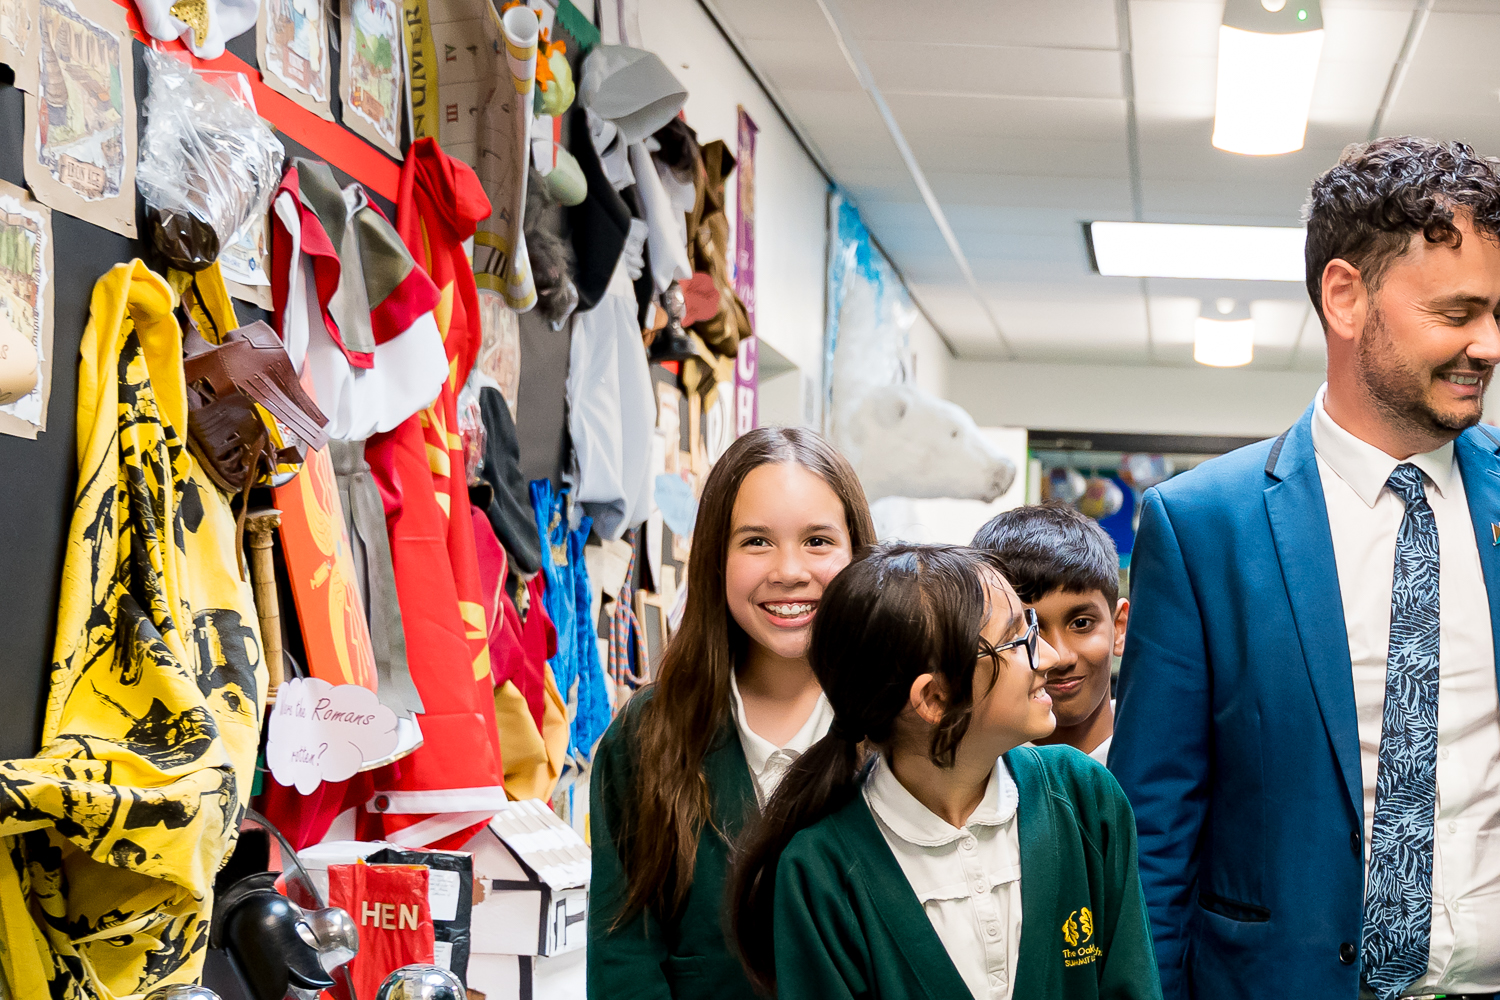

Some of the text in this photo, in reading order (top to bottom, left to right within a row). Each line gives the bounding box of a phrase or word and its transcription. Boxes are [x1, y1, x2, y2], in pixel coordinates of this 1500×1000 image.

[312, 697, 376, 726] Romans
[361, 900, 419, 931] HEN
[1062, 949, 1077, 958] The
